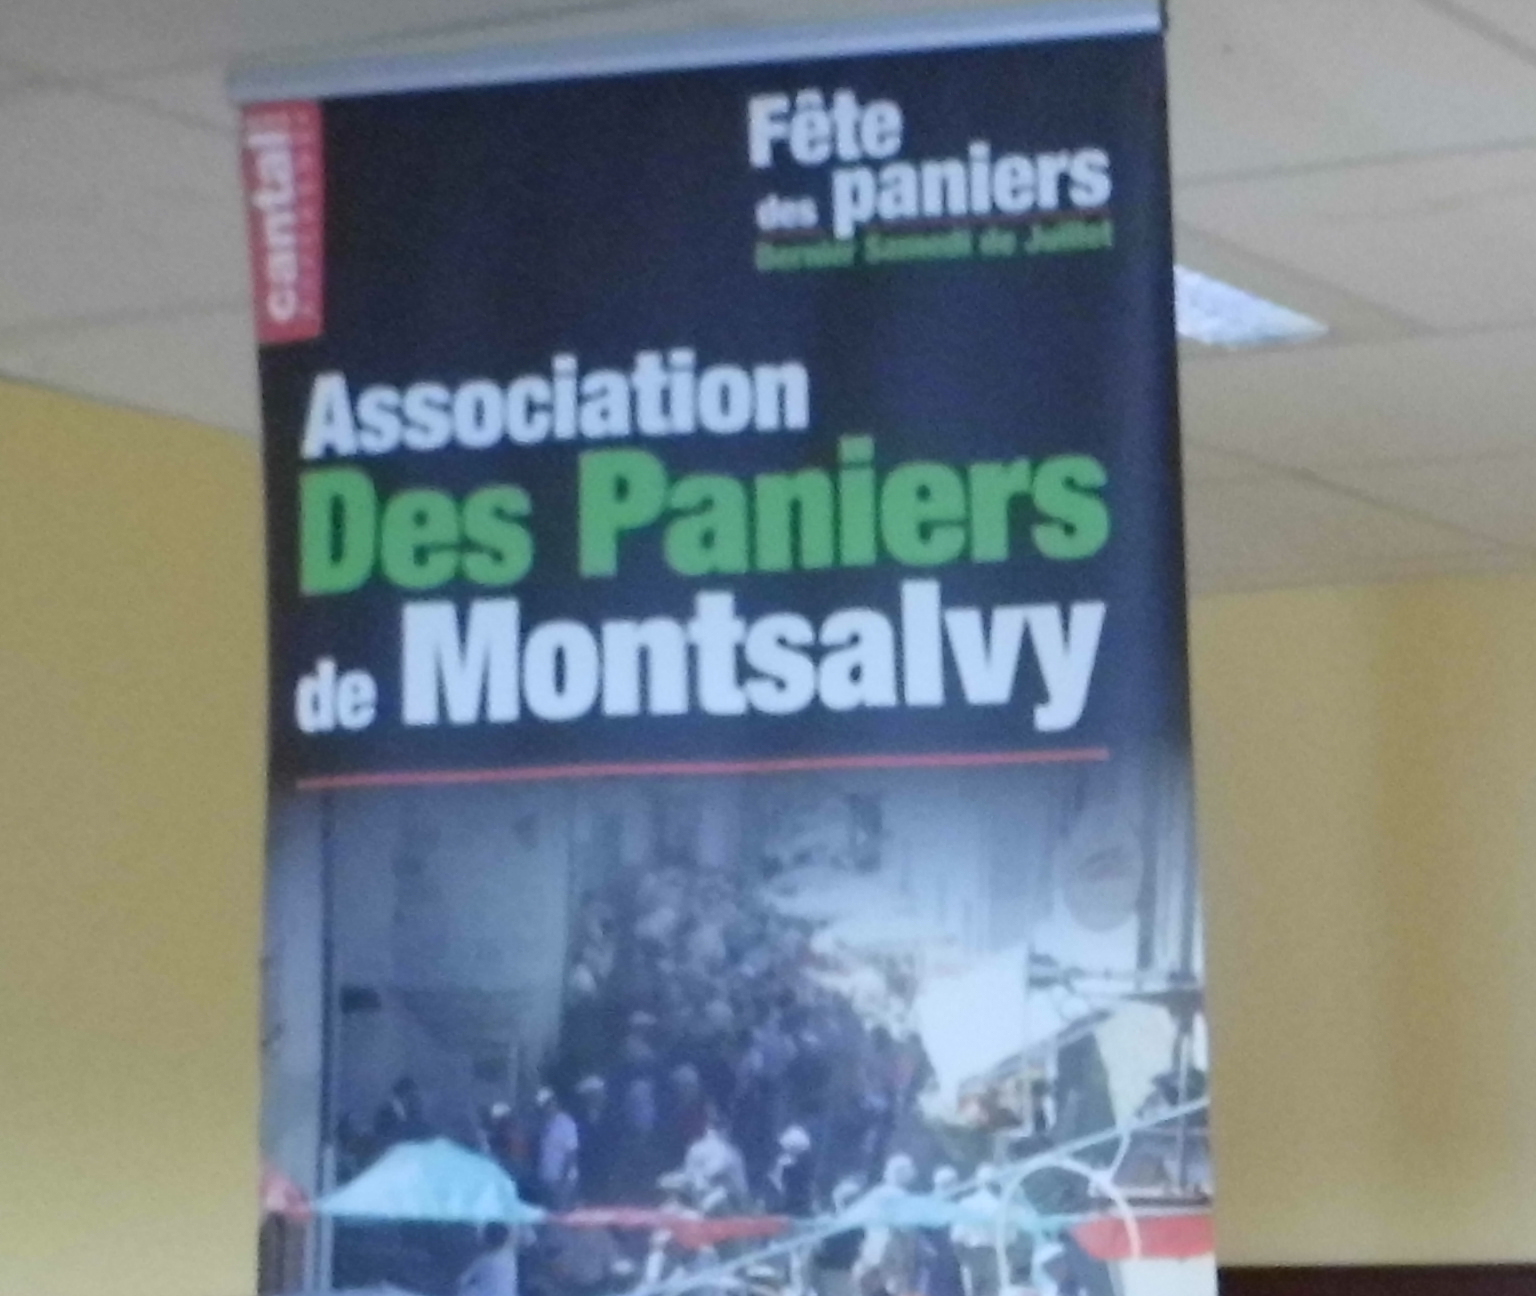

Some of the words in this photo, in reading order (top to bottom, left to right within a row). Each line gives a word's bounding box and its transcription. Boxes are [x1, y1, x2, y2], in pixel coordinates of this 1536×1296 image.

[748, 87, 904, 168] Fête
[755, 194, 819, 230] des
[832, 138, 1112, 240] paniers
[250, 131, 298, 323] cantal
[301, 348, 810, 459] Association
[299, 467, 535, 595] Des
[577, 437, 1111, 578] Paniers
[295, 658, 377, 733] de
[402, 579, 1107, 732] Montsalvy
